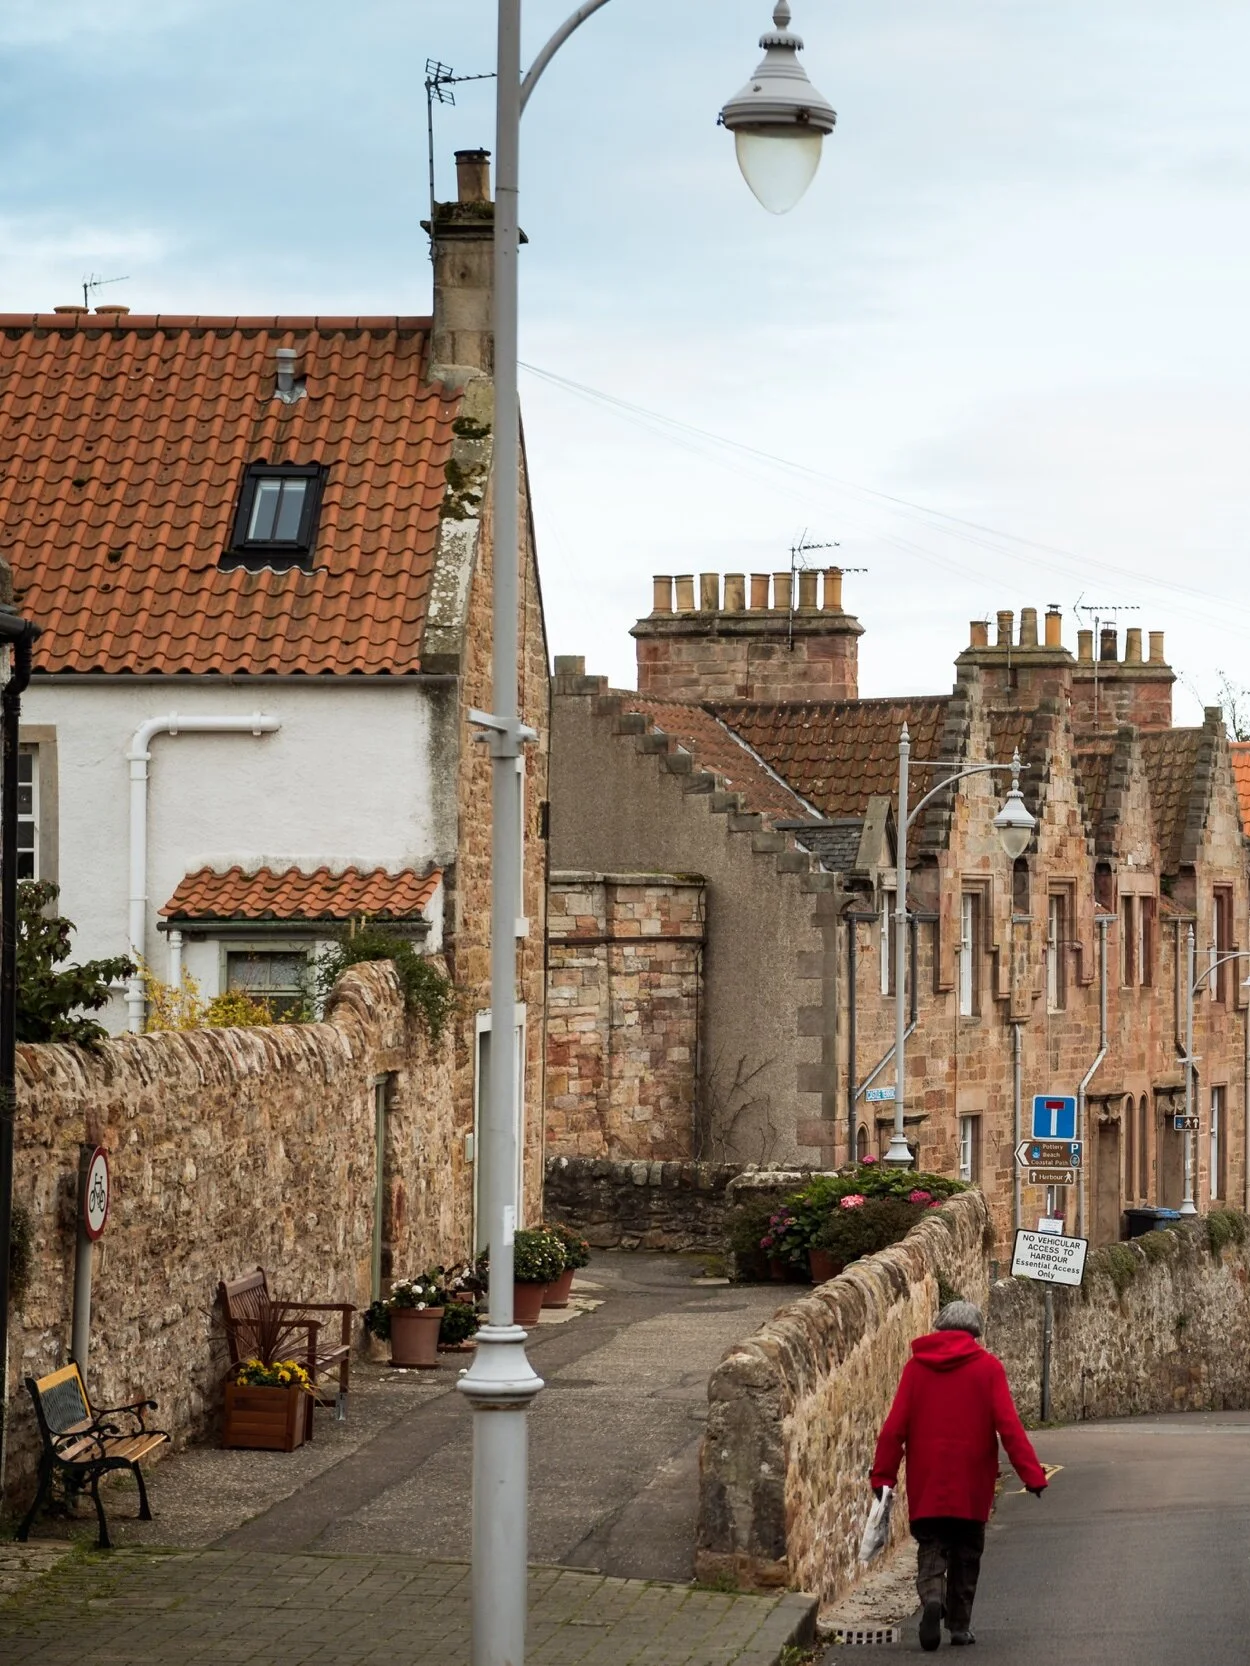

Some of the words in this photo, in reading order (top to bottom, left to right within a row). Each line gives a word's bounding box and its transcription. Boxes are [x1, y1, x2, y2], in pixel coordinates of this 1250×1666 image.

[1070, 1143, 1079, 1154] P
[1022, 1234, 1035, 1242] NO
[1038, 1236, 1081, 1249] VEHICULAR
[1027, 1243, 1060, 1254] ACCESS
[1063, 1248, 1074, 1257] TO
[1029, 1252, 1068, 1264] HARBOUR
[1015, 1258, 1050, 1270] Essential
[1052, 1264, 1080, 1275] Access
[1037, 1270, 1056, 1280] Only
